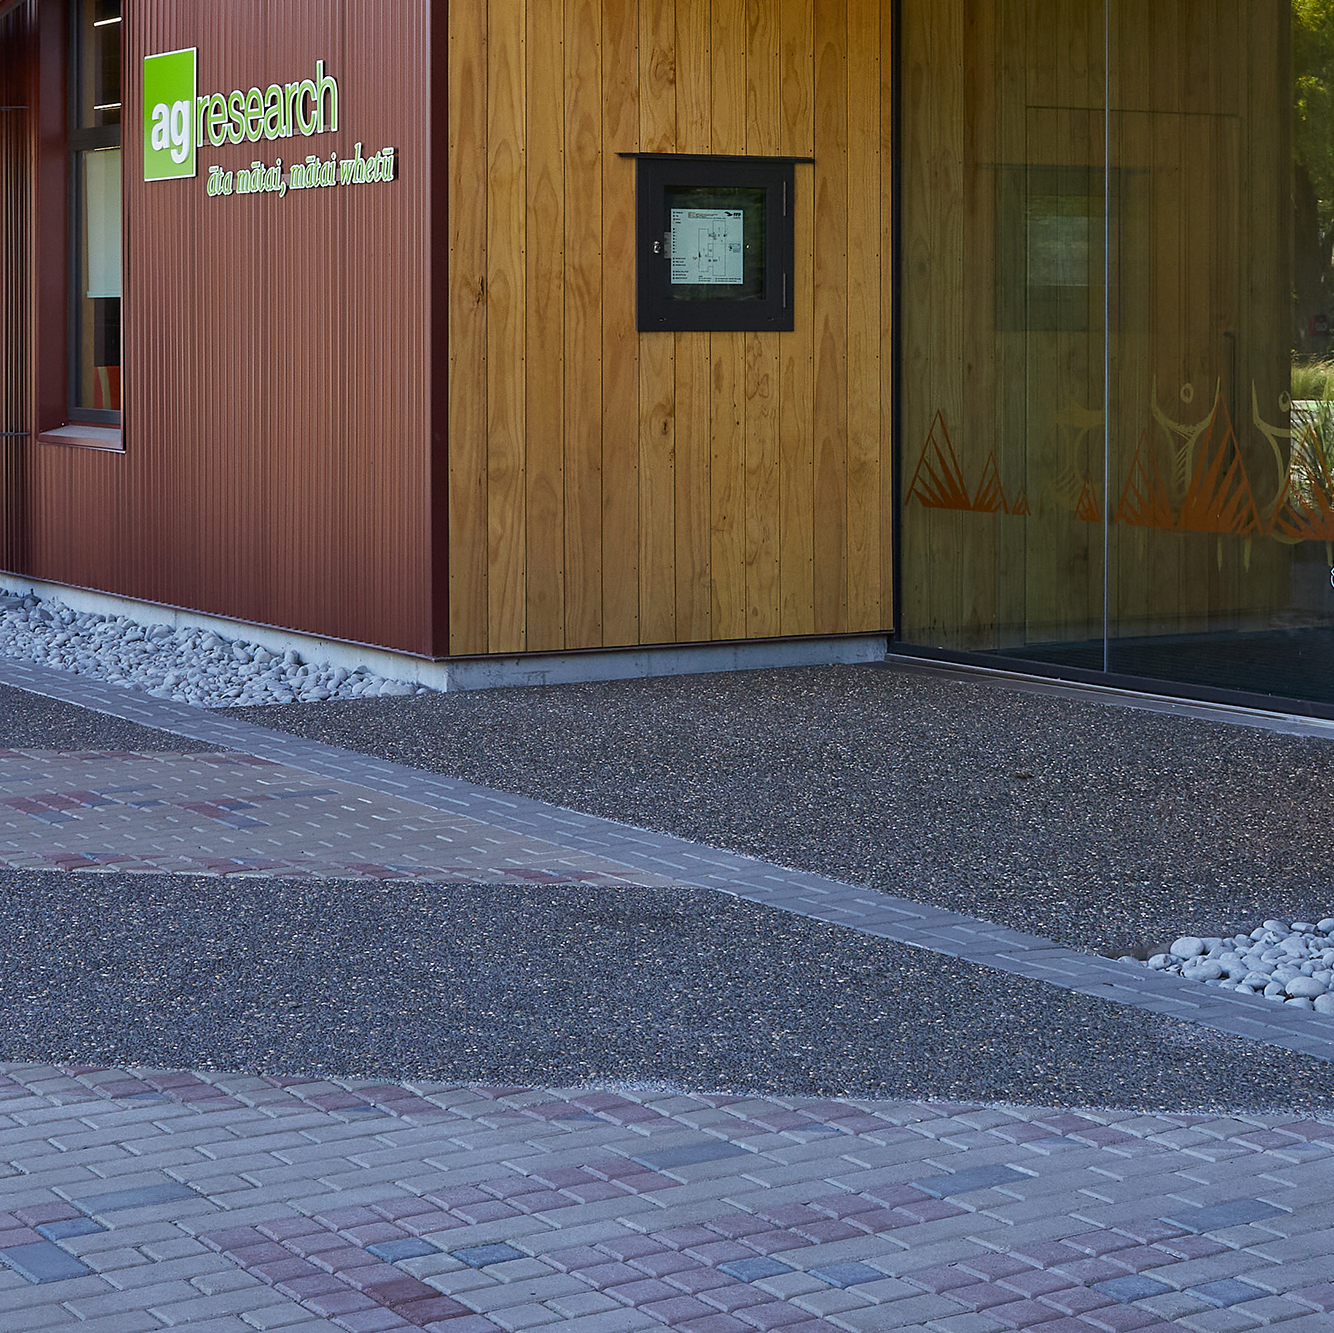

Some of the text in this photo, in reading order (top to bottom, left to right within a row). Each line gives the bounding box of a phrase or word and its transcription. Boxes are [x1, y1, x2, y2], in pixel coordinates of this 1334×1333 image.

[207, 142, 394, 198] āta mātai, mātai whetū
